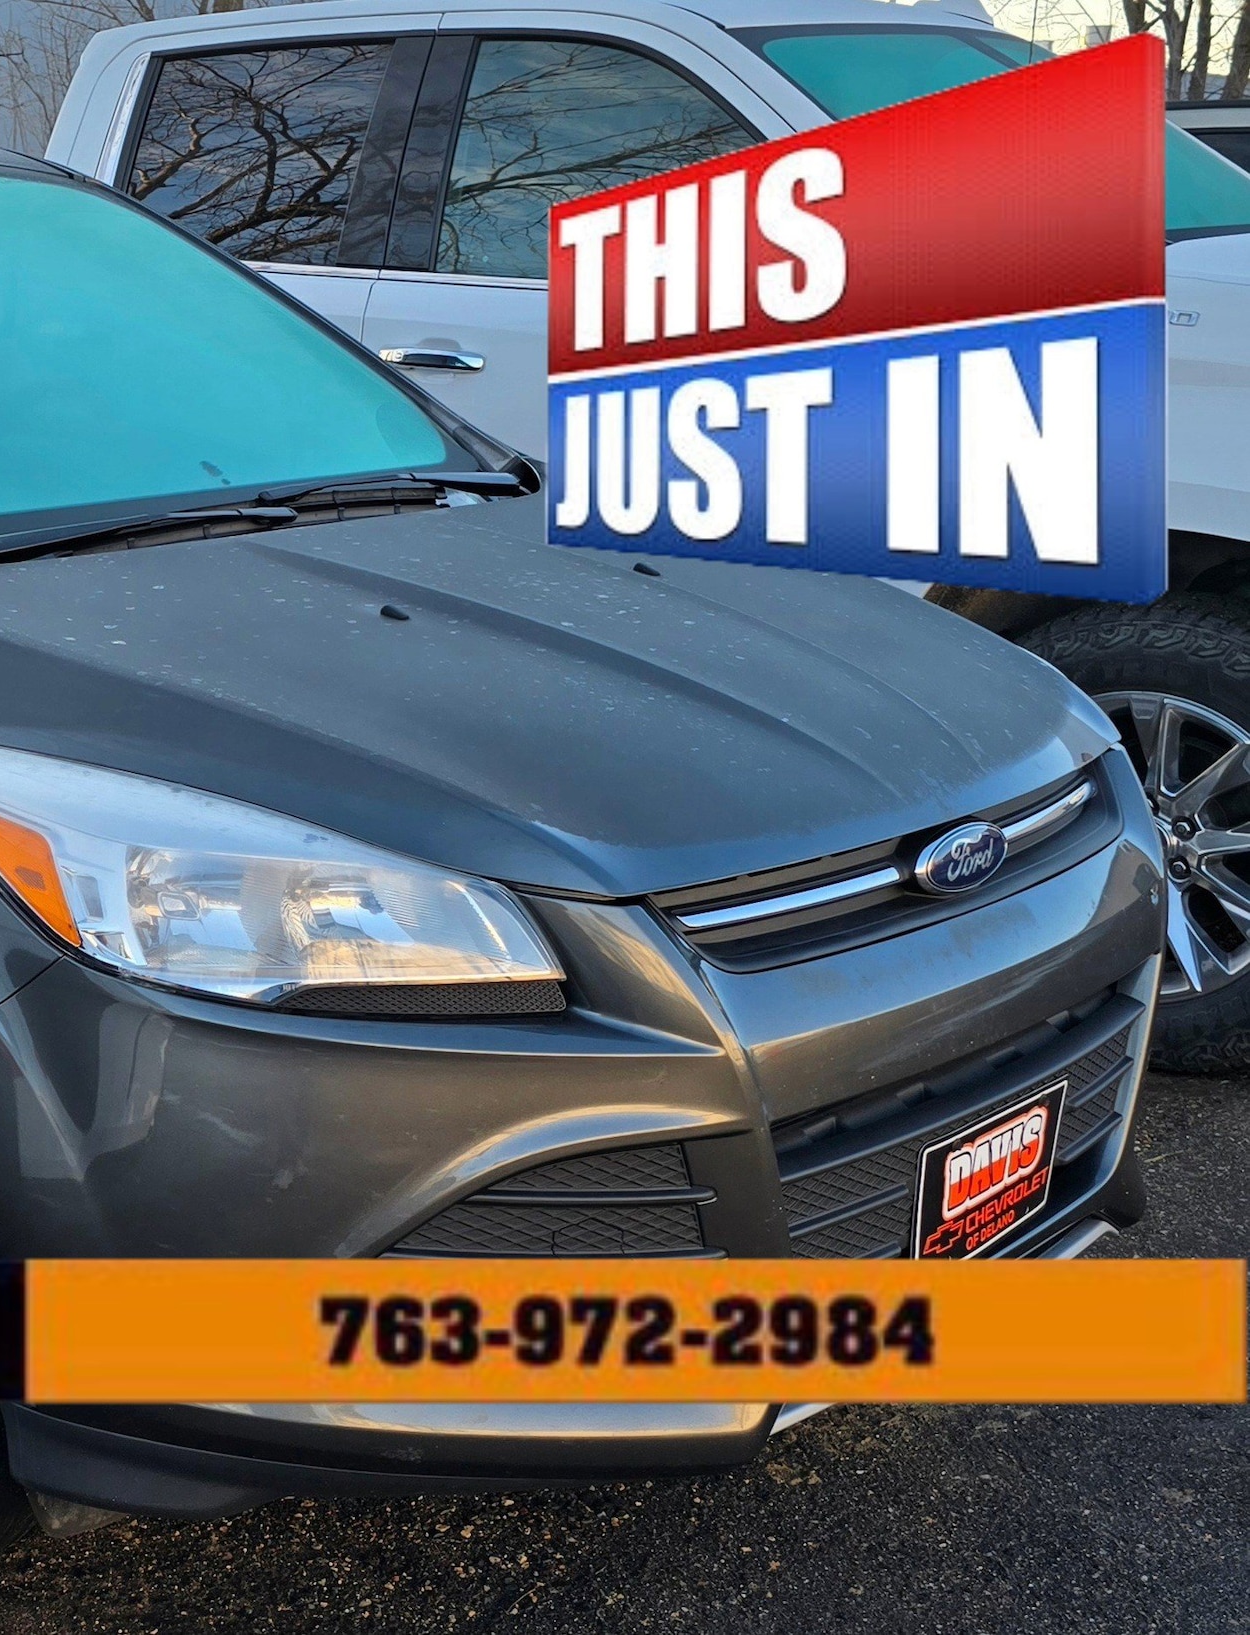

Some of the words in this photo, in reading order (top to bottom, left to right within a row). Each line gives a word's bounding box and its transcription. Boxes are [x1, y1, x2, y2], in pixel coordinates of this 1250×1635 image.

[946, 831, 995, 882] Ford
[947, 1113, 1043, 1212] DAVIS
[965, 1165, 1049, 1234] CHEVROLET
[965, 1231, 981, 1251] OF
[980, 1209, 1015, 1242] DELANO
